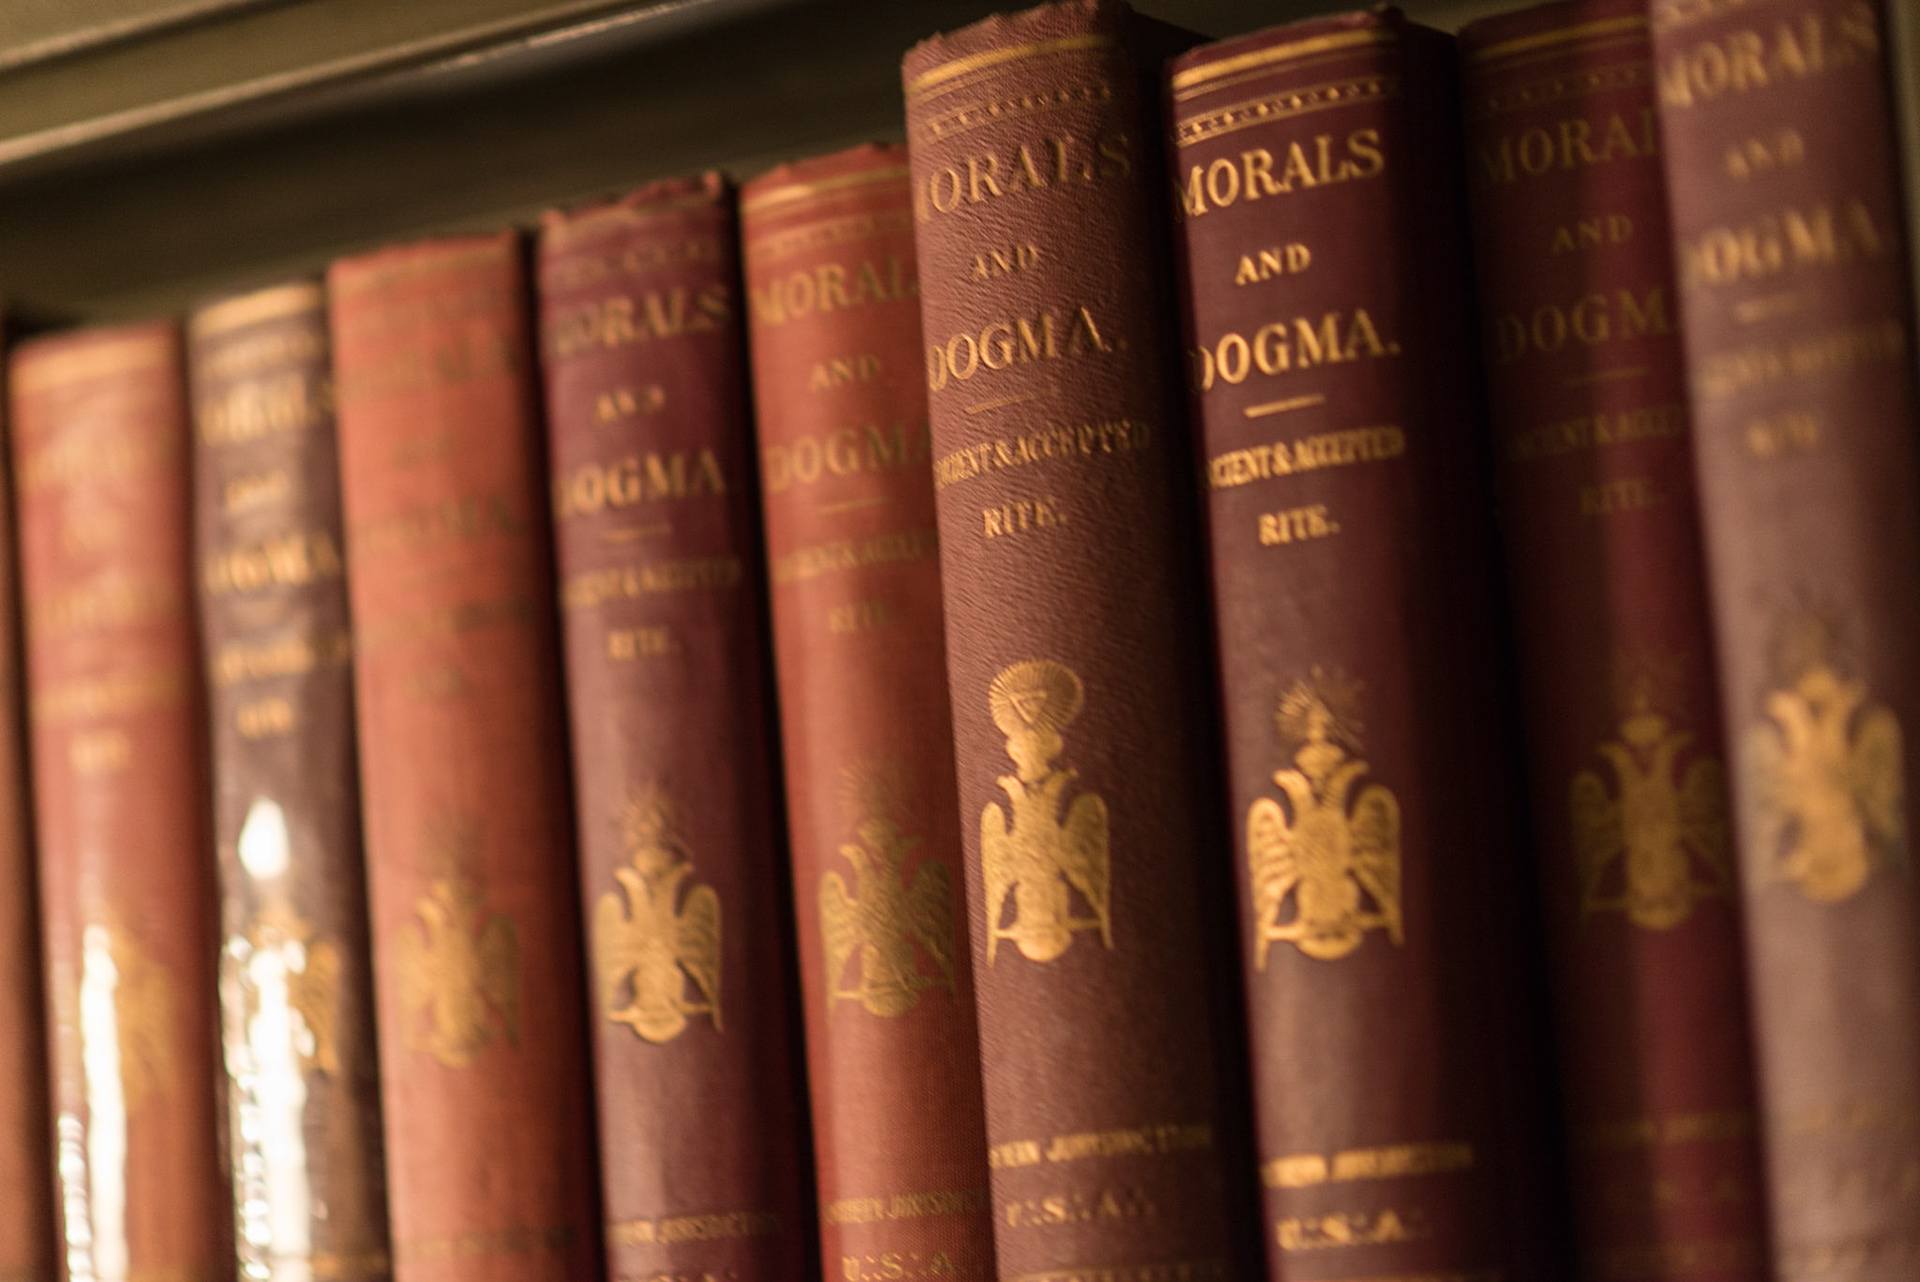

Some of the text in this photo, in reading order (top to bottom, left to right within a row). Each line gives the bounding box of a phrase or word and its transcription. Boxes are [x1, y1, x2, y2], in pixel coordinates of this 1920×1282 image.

[1553, 214, 1634, 256] AND
[973, 245, 1037, 282] AND
[1234, 243, 1312, 286] AND
[811, 355, 881, 393] AND
